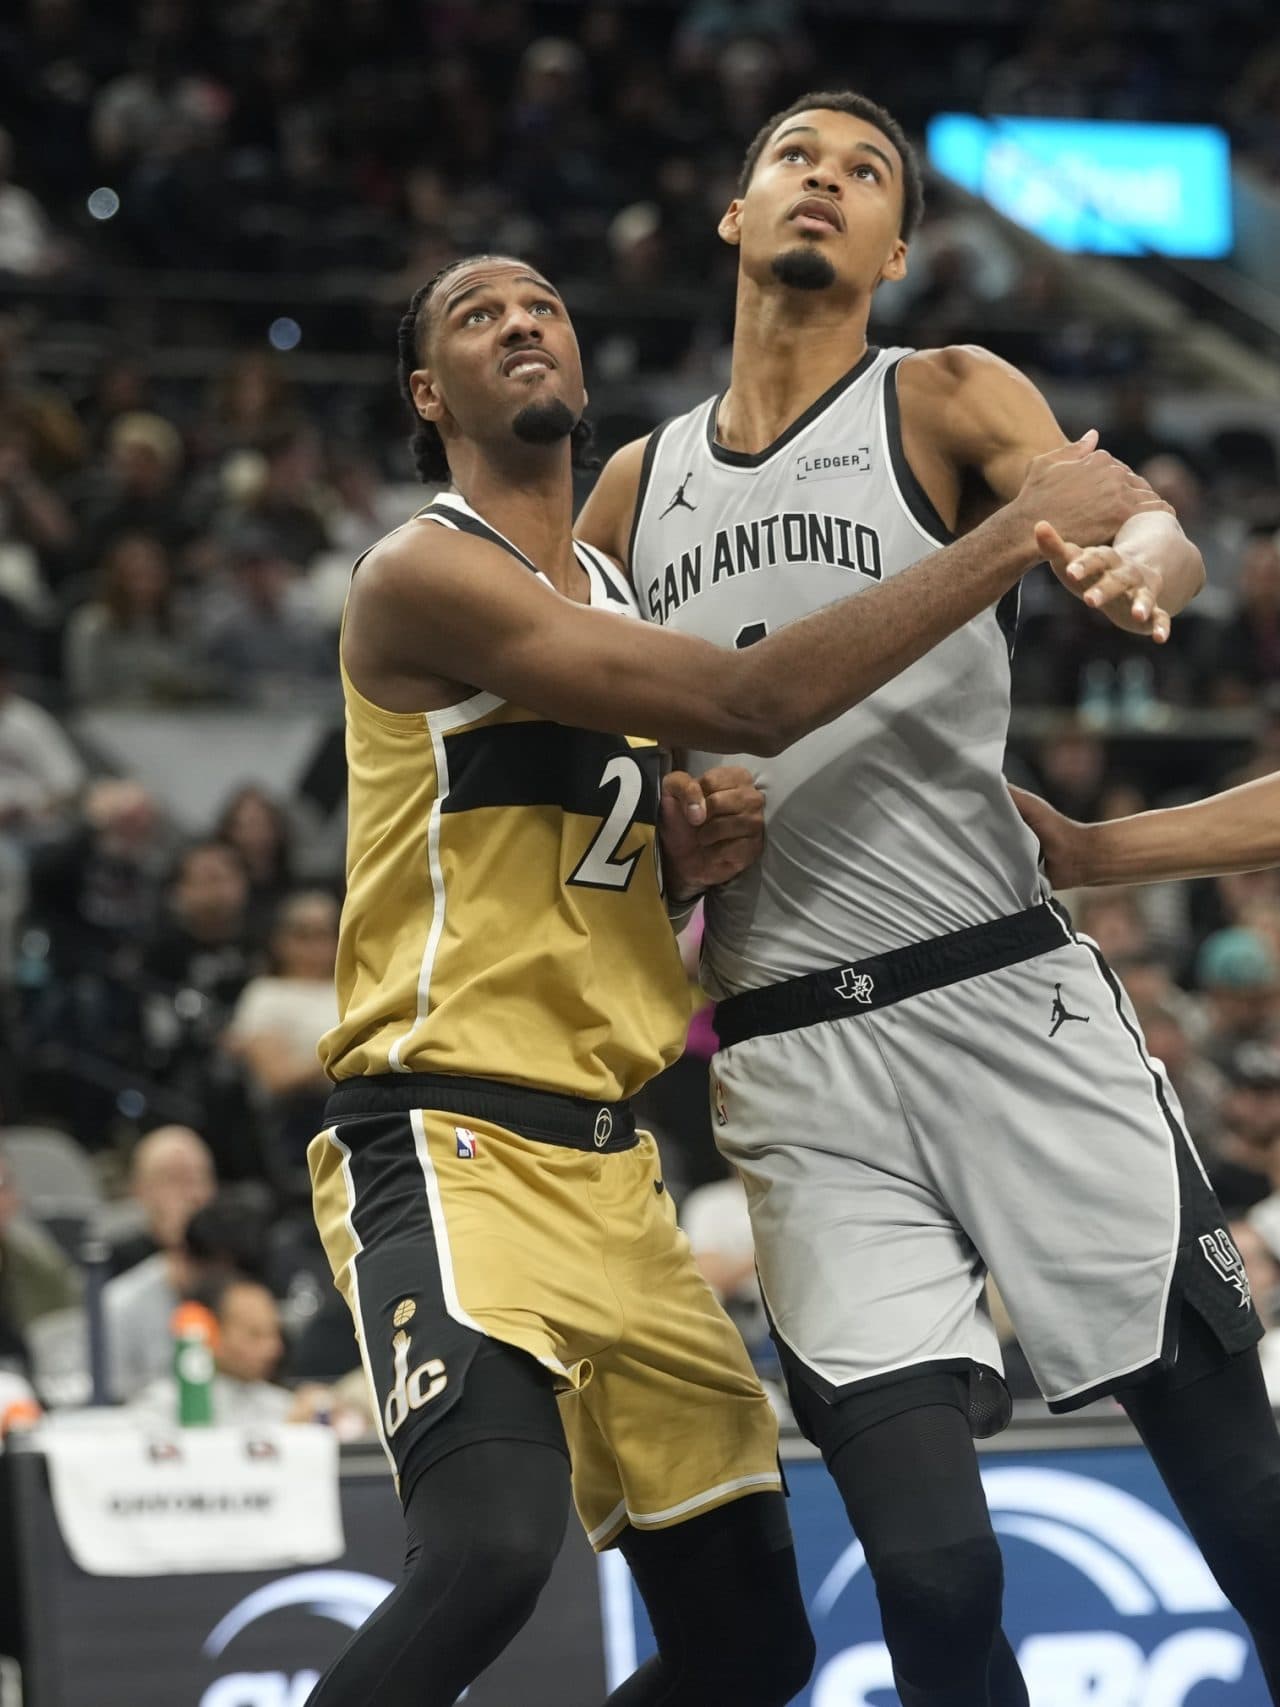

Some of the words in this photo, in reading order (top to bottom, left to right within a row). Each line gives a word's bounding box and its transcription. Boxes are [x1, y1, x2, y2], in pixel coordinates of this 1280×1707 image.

[804, 454, 860, 473] LEDGER
[648, 543, 702, 626] SAN
[711, 511, 884, 586] ANTONIO
[566, 752, 647, 892] 2
